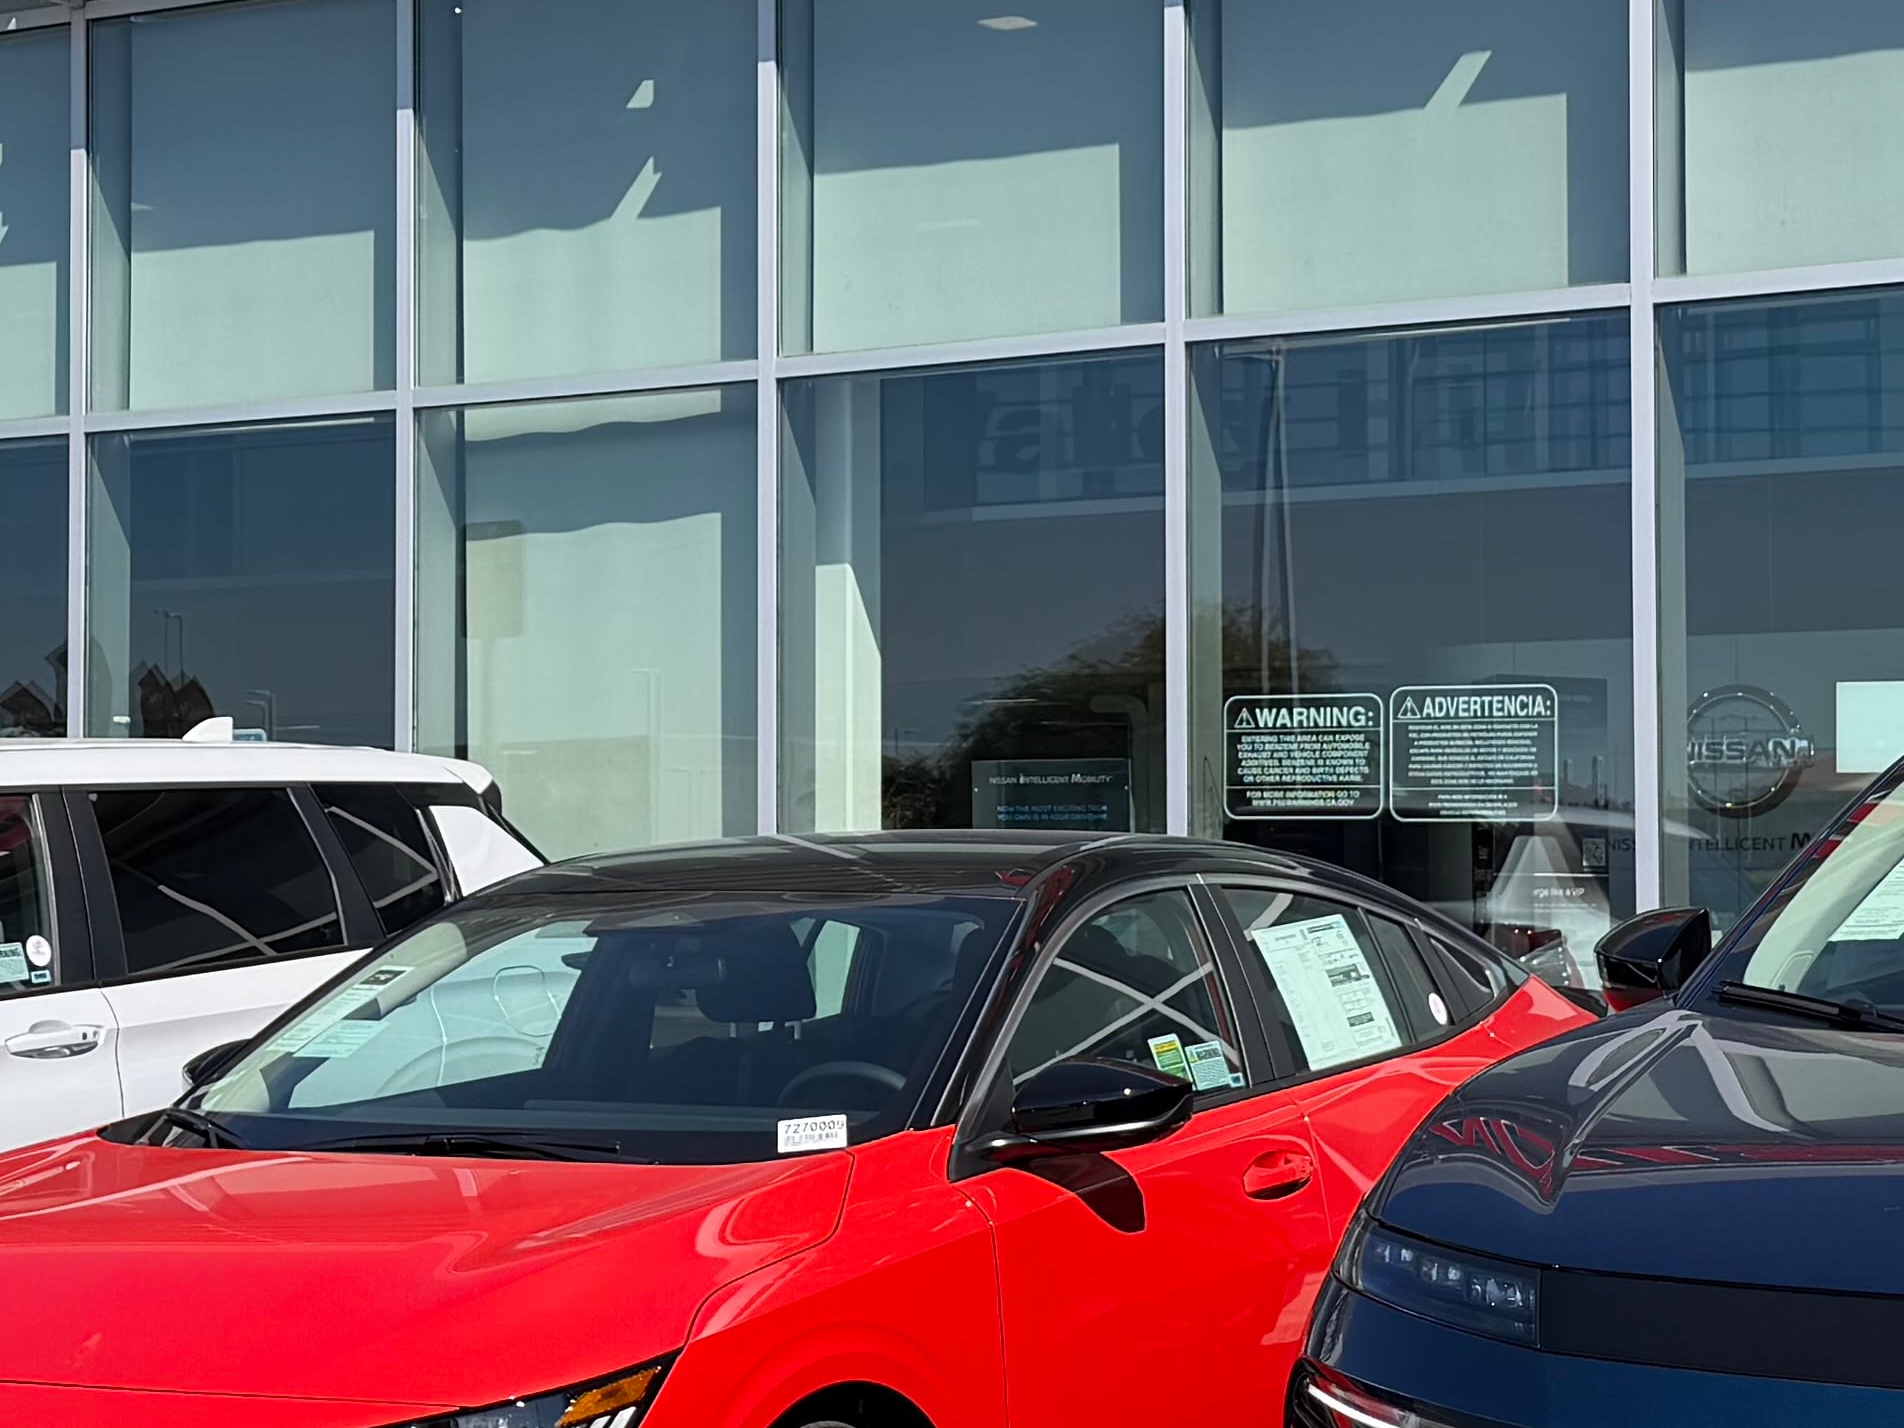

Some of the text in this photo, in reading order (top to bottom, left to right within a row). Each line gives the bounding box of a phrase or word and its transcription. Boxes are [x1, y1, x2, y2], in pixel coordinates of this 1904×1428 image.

[1255, 706, 1374, 728] WARNING:
[1422, 694, 1551, 718] ADVERTENCIA:
[1687, 737, 1796, 763] NISSAN
